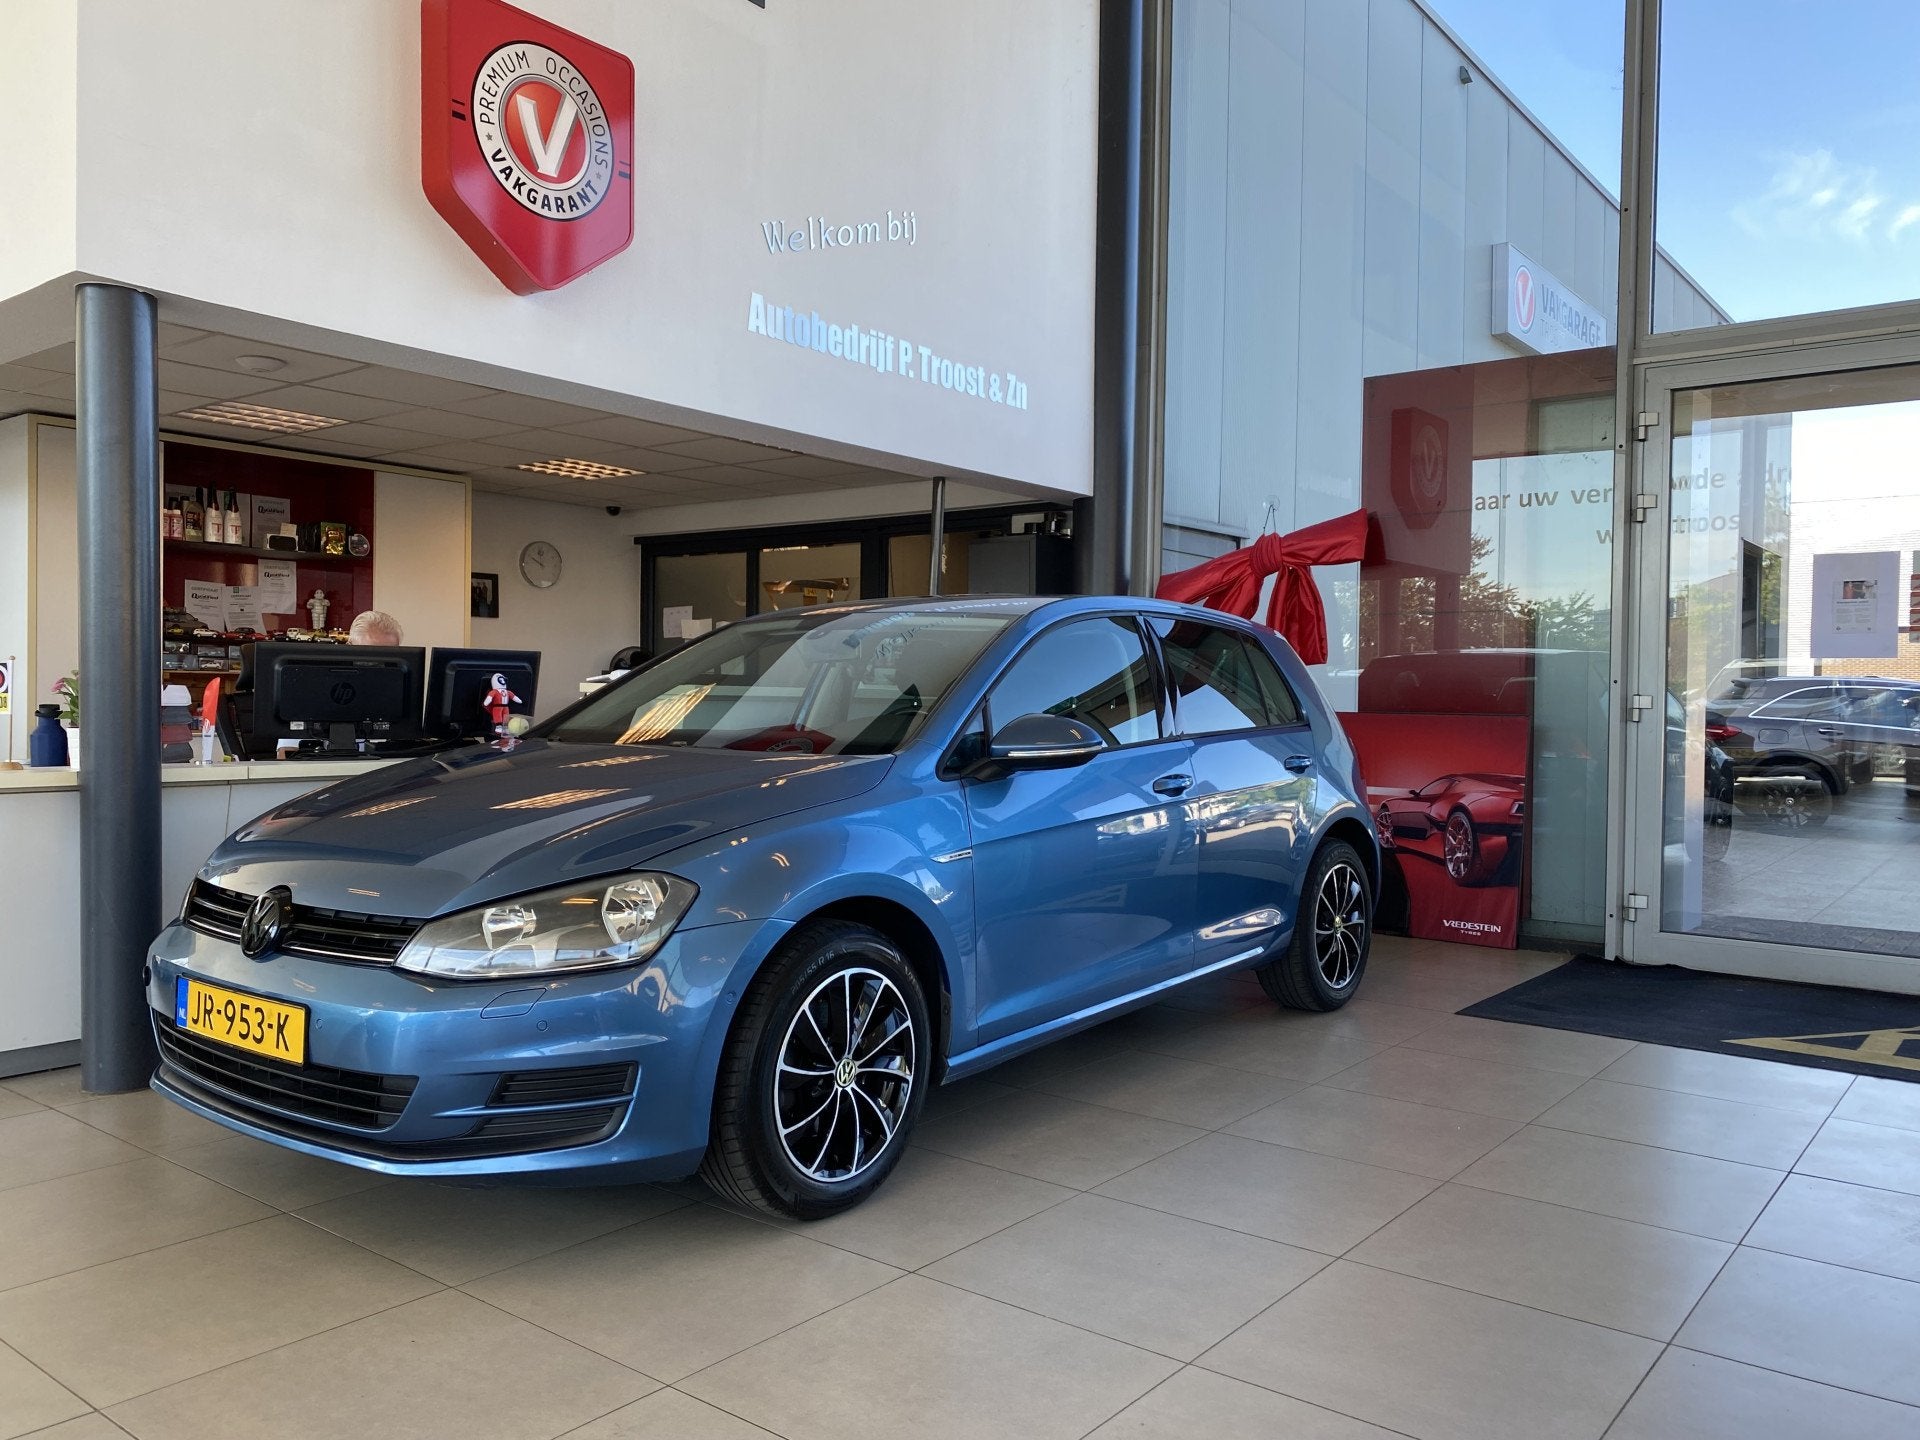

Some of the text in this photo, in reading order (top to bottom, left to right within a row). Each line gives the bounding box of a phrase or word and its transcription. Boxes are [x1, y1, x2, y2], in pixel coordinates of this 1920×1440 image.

[479, 50, 608, 169] PREMIUM OCCASIONS
[516, 93, 578, 178] V
[491, 148, 598, 213] VAKGARANT
[761, 210, 917, 255] Welkom bij
[748, 292, 1028, 410] Autobedrijf P. Troost & Zn
[1519, 490, 1559, 508] uw
[1443, 919, 1502, 933] VREDESTEIN
[179, 1006, 187, 1020] NL
[191, 990, 290, 1052] JR-953-K
